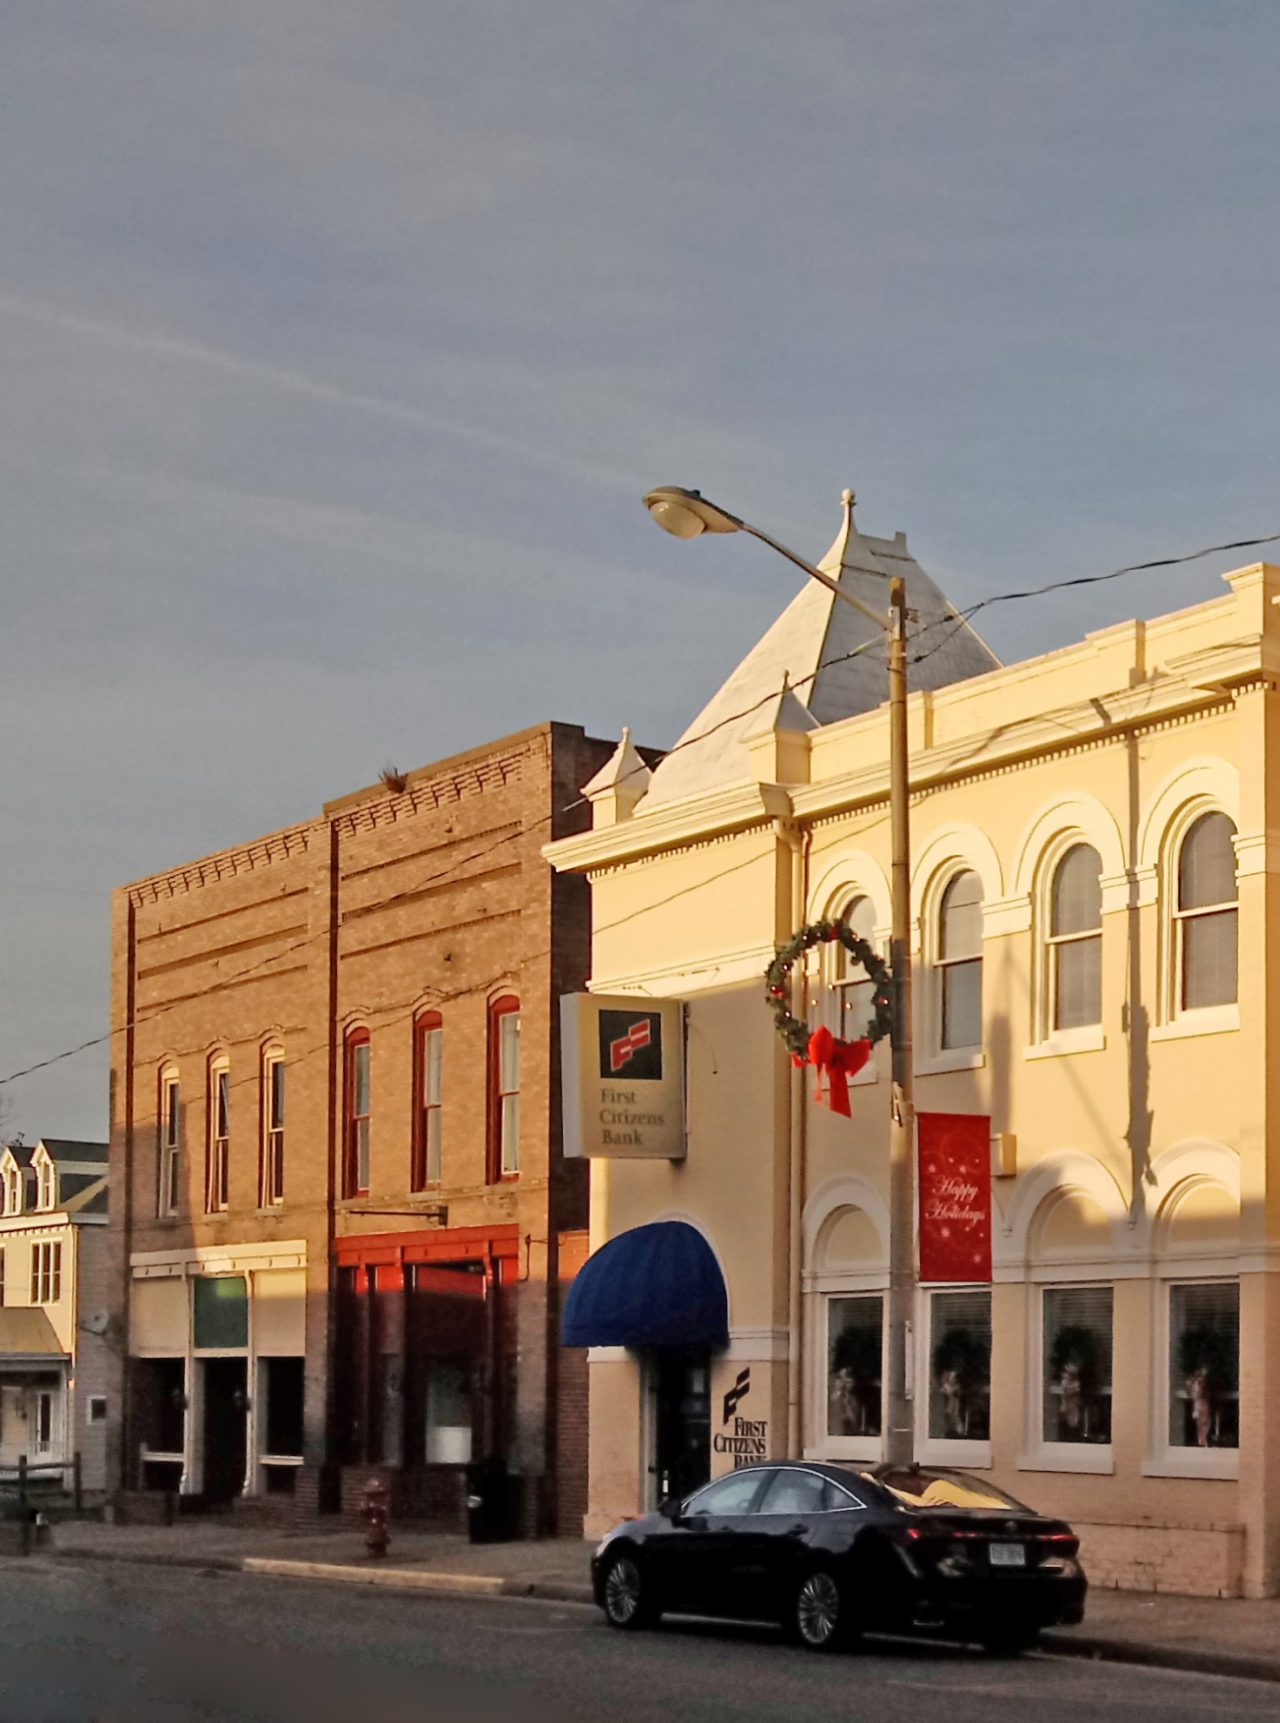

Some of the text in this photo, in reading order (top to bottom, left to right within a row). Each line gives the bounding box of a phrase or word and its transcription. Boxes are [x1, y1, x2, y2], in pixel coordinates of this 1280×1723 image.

[600, 1088, 636, 1104] First
[600, 1109, 665, 1125] Citizens
[602, 1129, 643, 1145] Bank
[932, 1176, 978, 1200] Happy
[925, 1199, 985, 1226] Holidays
[734, 1417, 768, 1437] FIRST
[713, 1433, 767, 1454] CITIZENS
